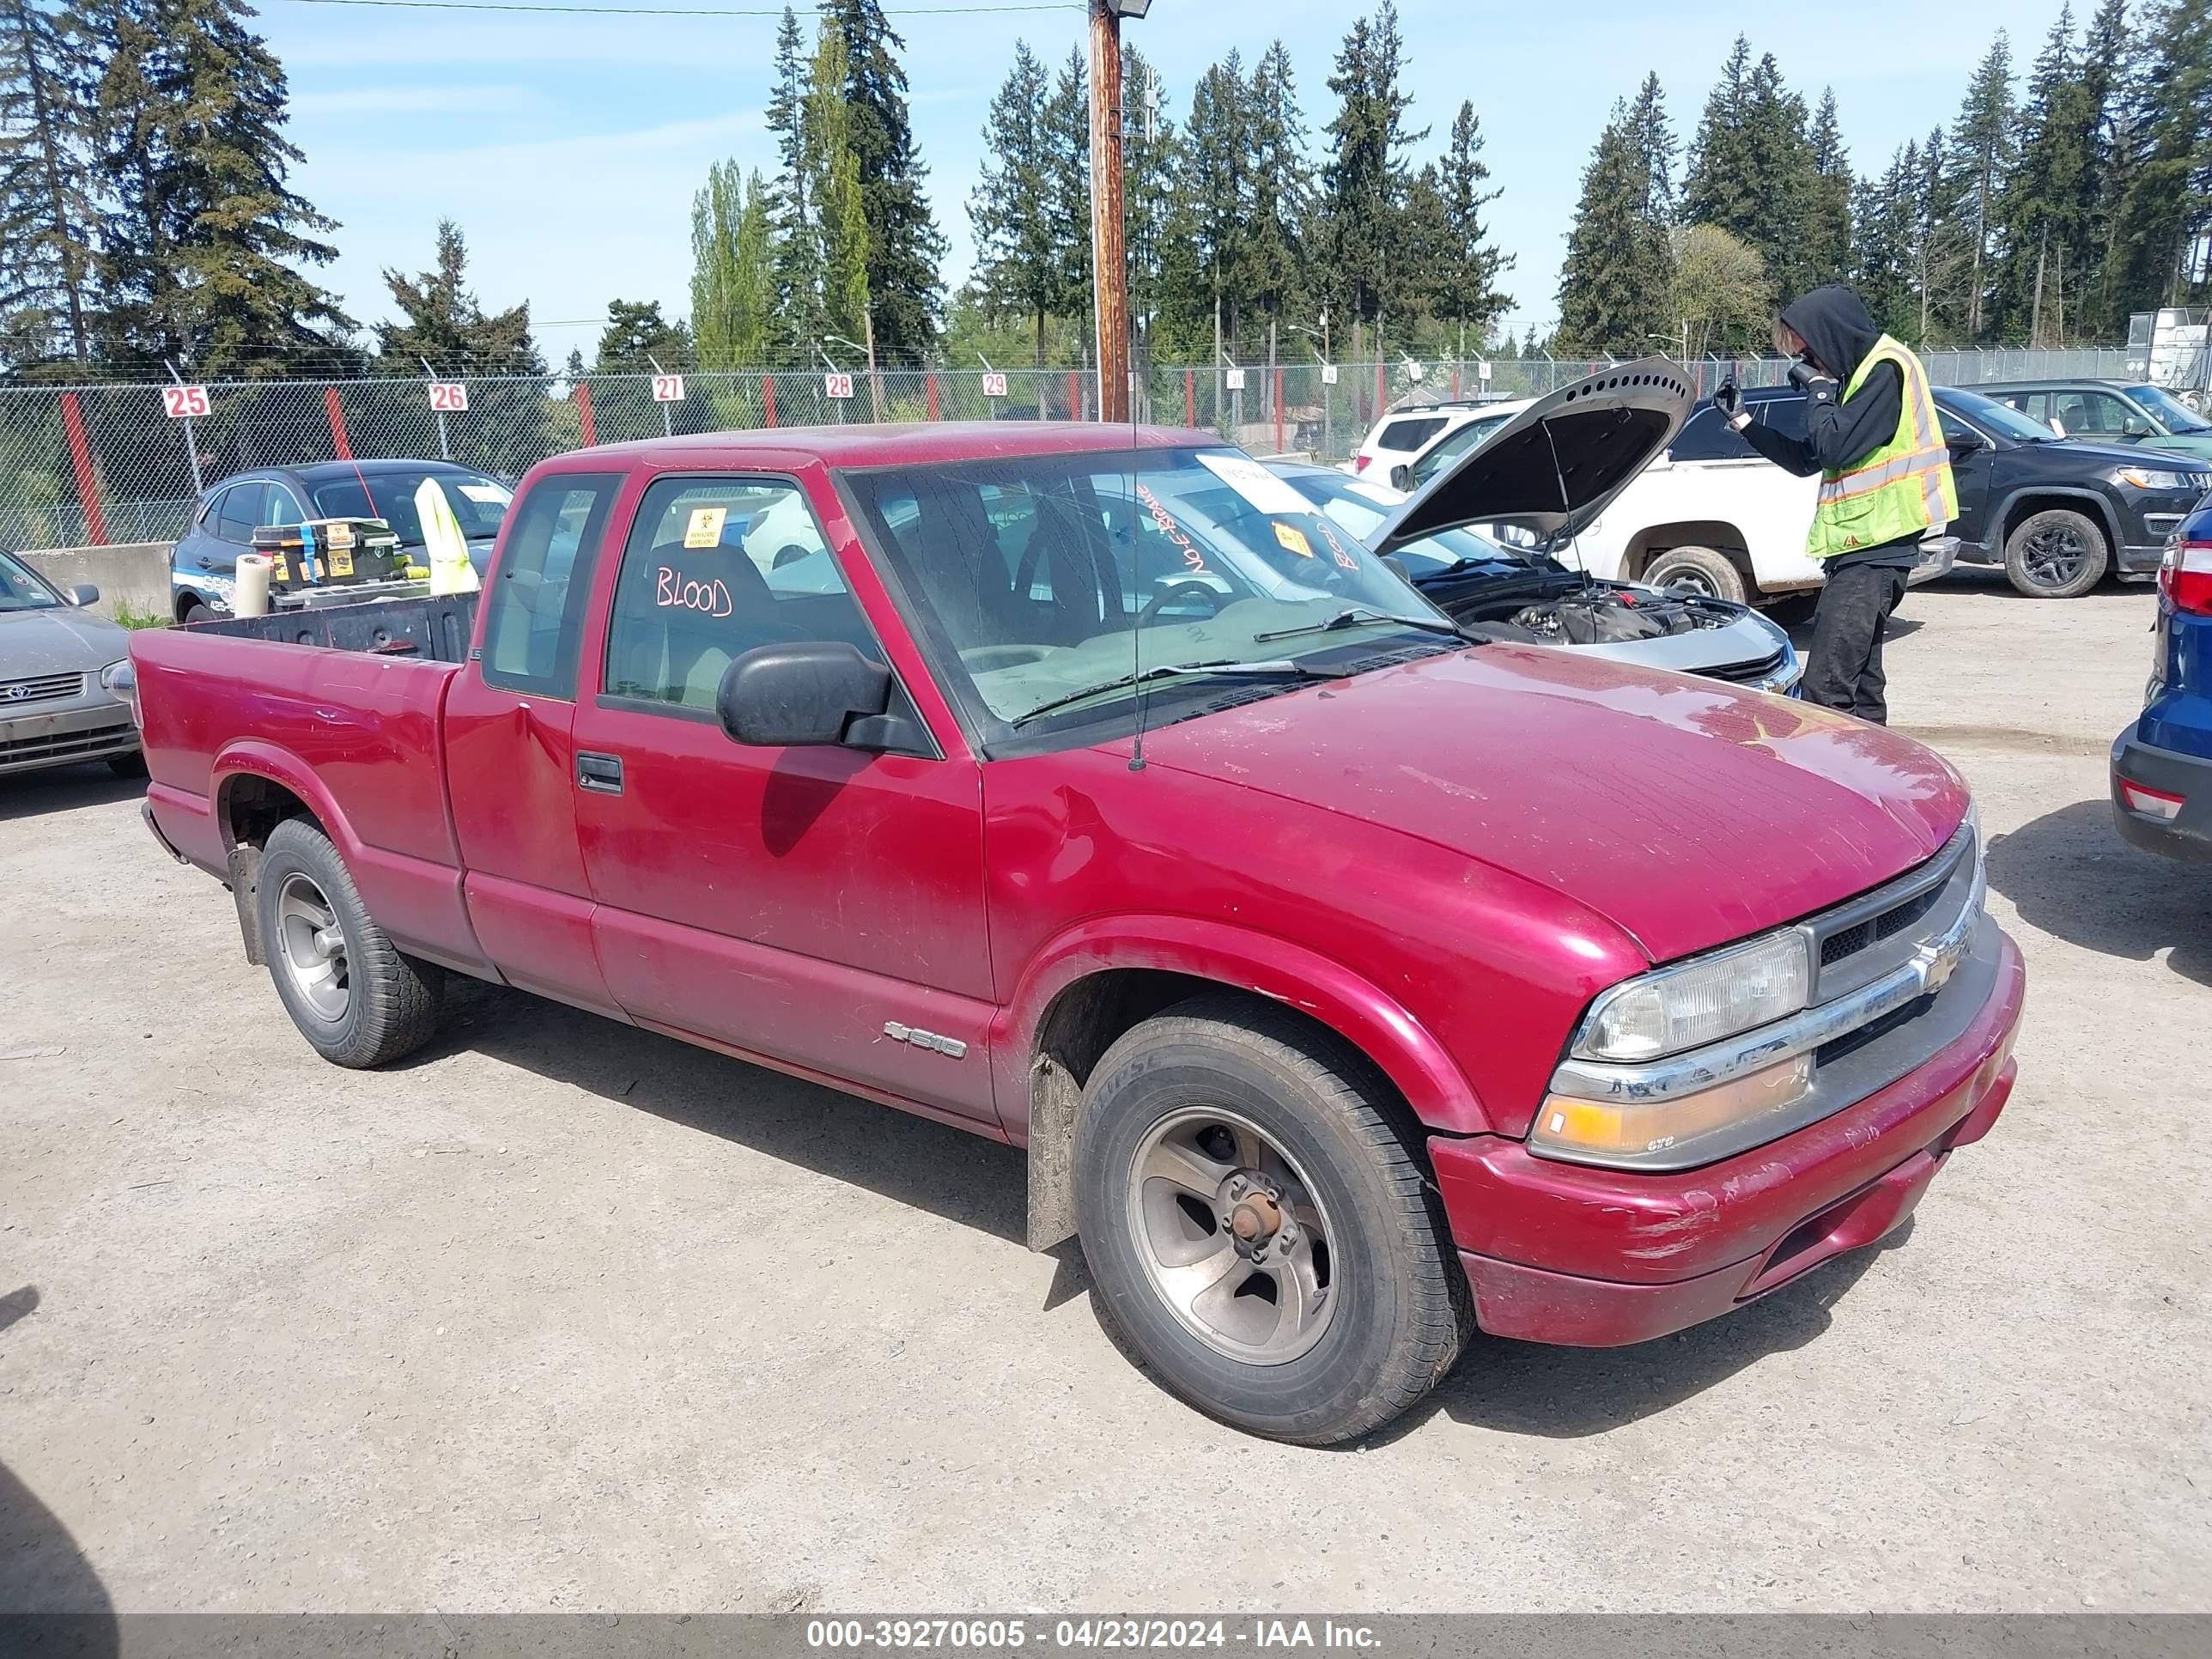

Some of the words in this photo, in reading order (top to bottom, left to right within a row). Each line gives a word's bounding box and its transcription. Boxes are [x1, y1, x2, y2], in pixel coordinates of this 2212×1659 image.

[656, 378, 678, 399] 27
[829, 376, 850, 396] 28
[986, 375, 1004, 394] 29
[167, 388, 206, 416] 25
[433, 386, 464, 409] 26
[656, 567, 732, 617] BLOOD
